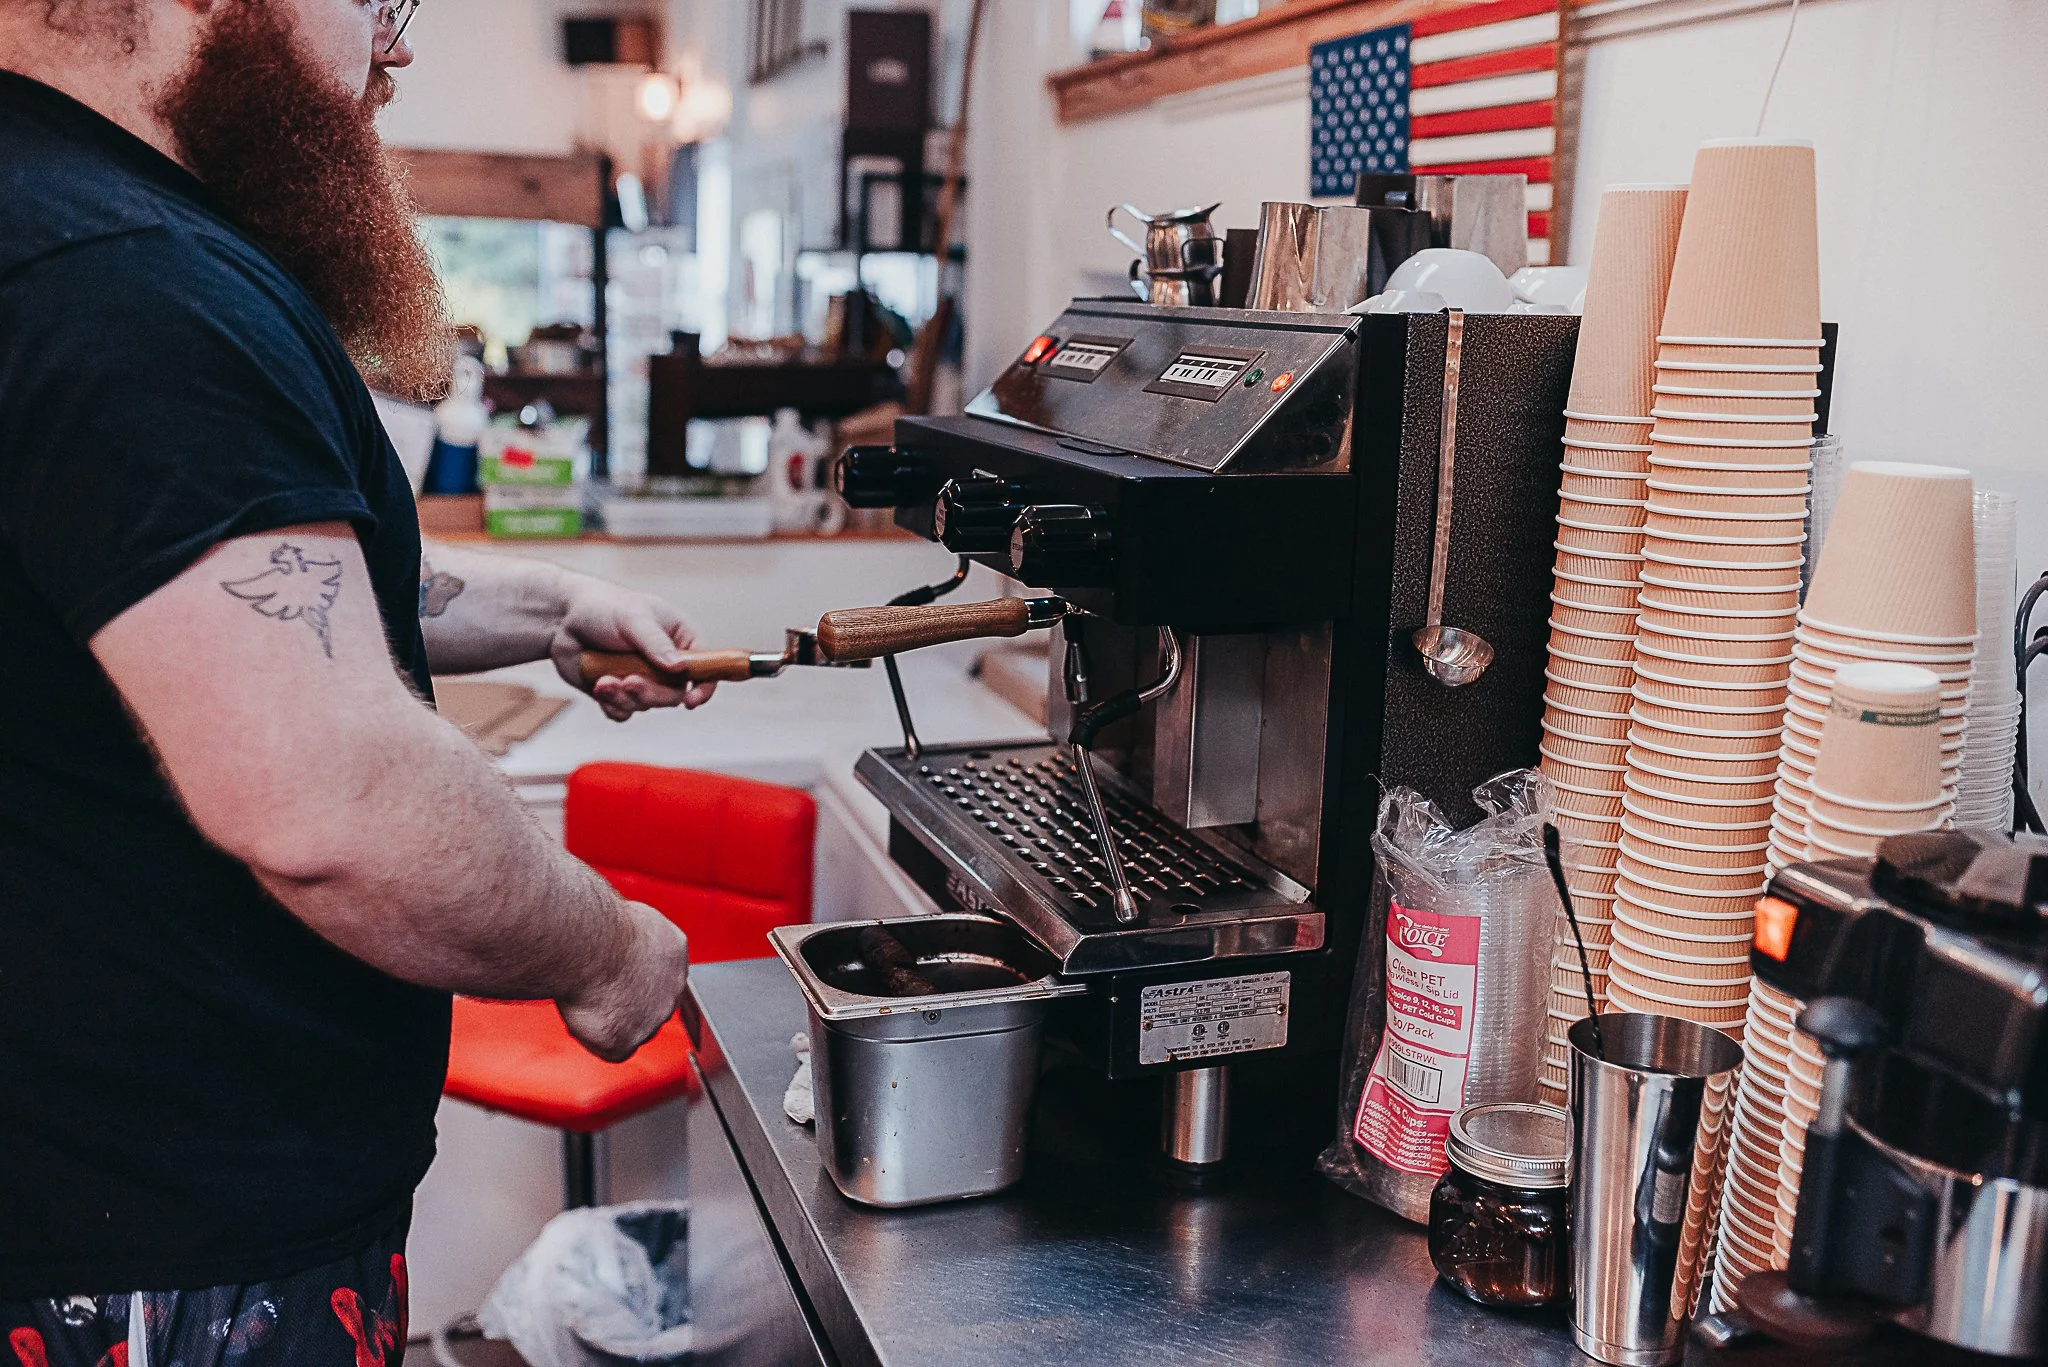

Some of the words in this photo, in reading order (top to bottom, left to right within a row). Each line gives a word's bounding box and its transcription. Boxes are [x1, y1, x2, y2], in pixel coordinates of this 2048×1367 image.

[1392, 957, 1417, 978] Clear
[1421, 971, 1445, 987] PET
[1426, 985, 1440, 997] Sip
[1443, 989, 1459, 1000] Lid
[1402, 1003, 1417, 1013] PET
[1418, 1009, 1434, 1020] Cold
[1436, 1015, 1456, 1025] Cups
[1412, 997, 1420, 1006] 9,
[1421, 1000, 1430, 1009] 12,
[1443, 1008, 1456, 1017] 20,
[1393, 1014, 1434, 1039] 50/Pack
[1402, 1108, 1427, 1128] Cups:
